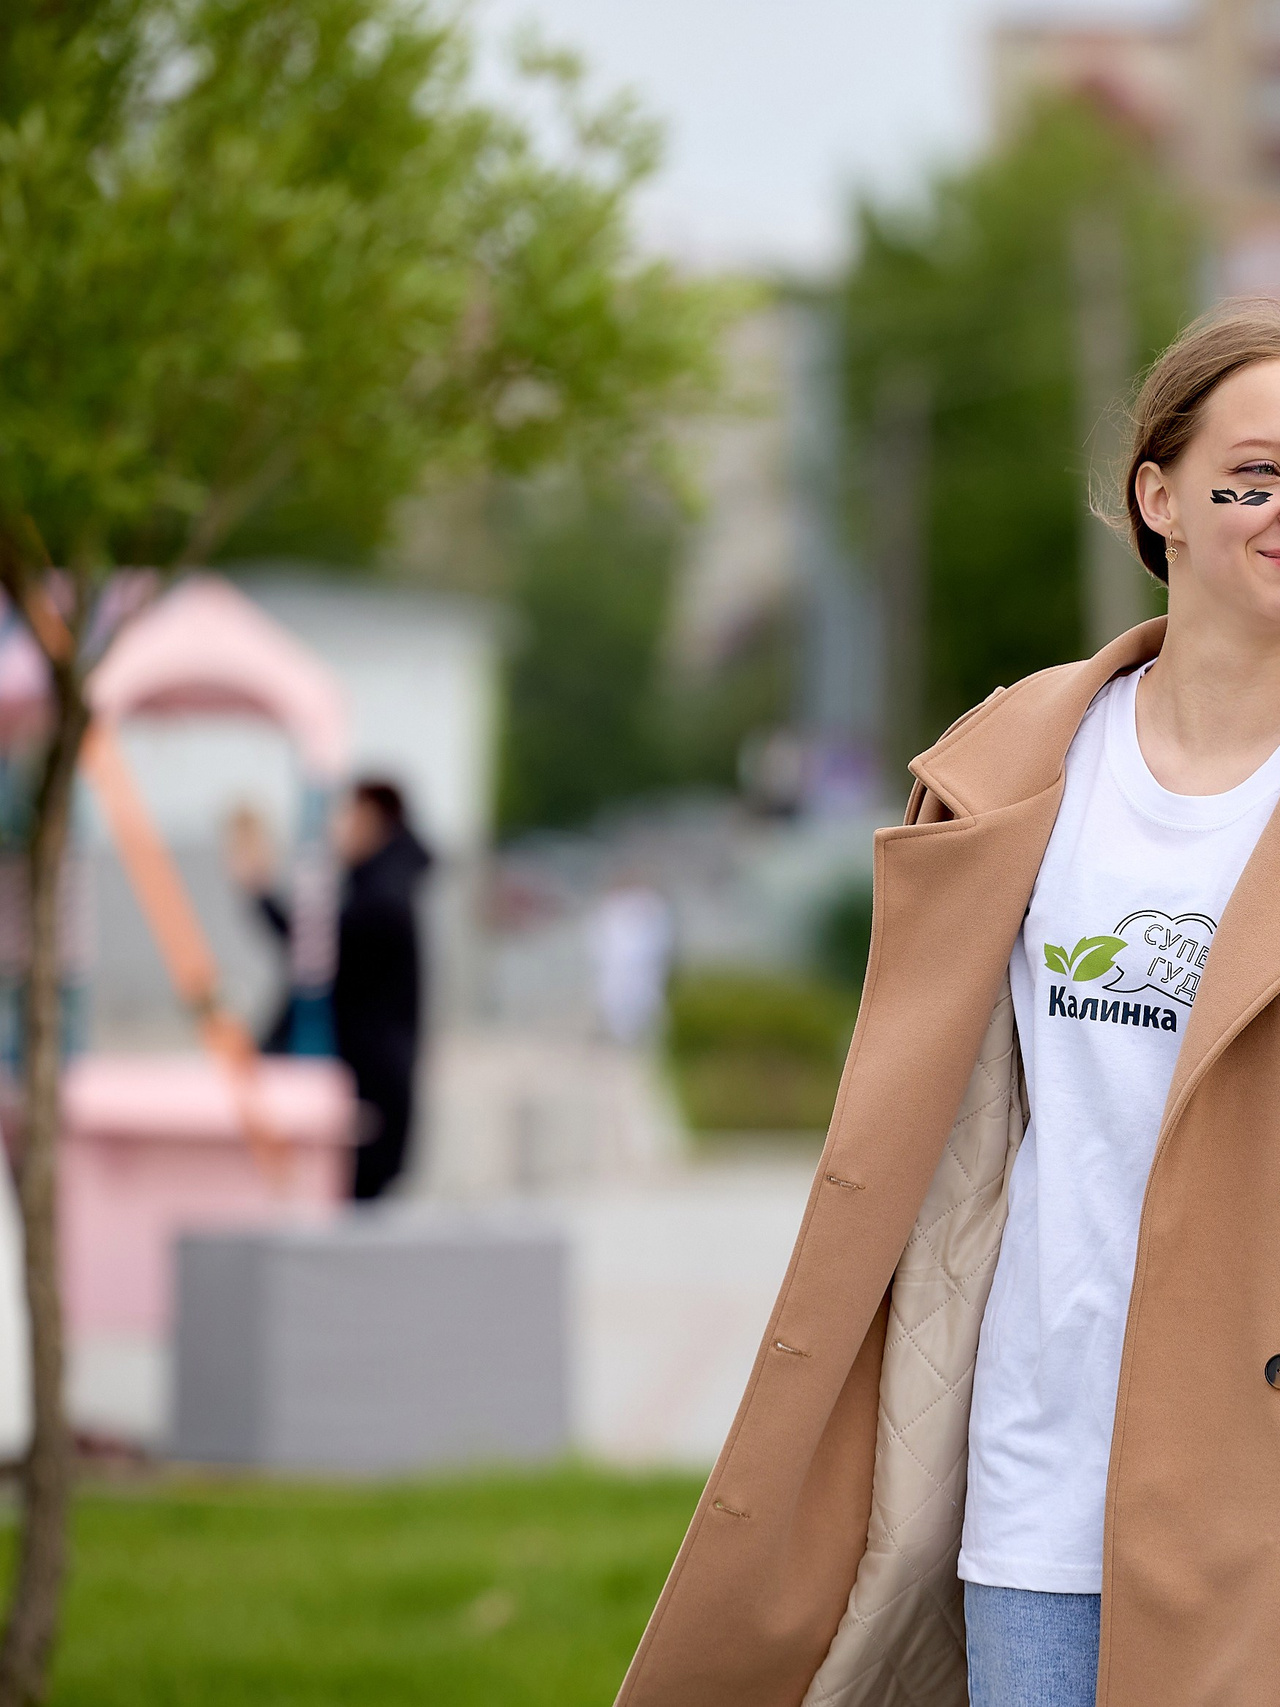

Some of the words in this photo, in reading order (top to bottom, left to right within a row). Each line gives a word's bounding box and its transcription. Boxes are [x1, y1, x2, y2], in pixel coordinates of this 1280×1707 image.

[1144, 924, 1209, 969] СУПЕ
[1147, 957, 1201, 1001] ГУД
[1049, 985, 1177, 1032] Калинка
